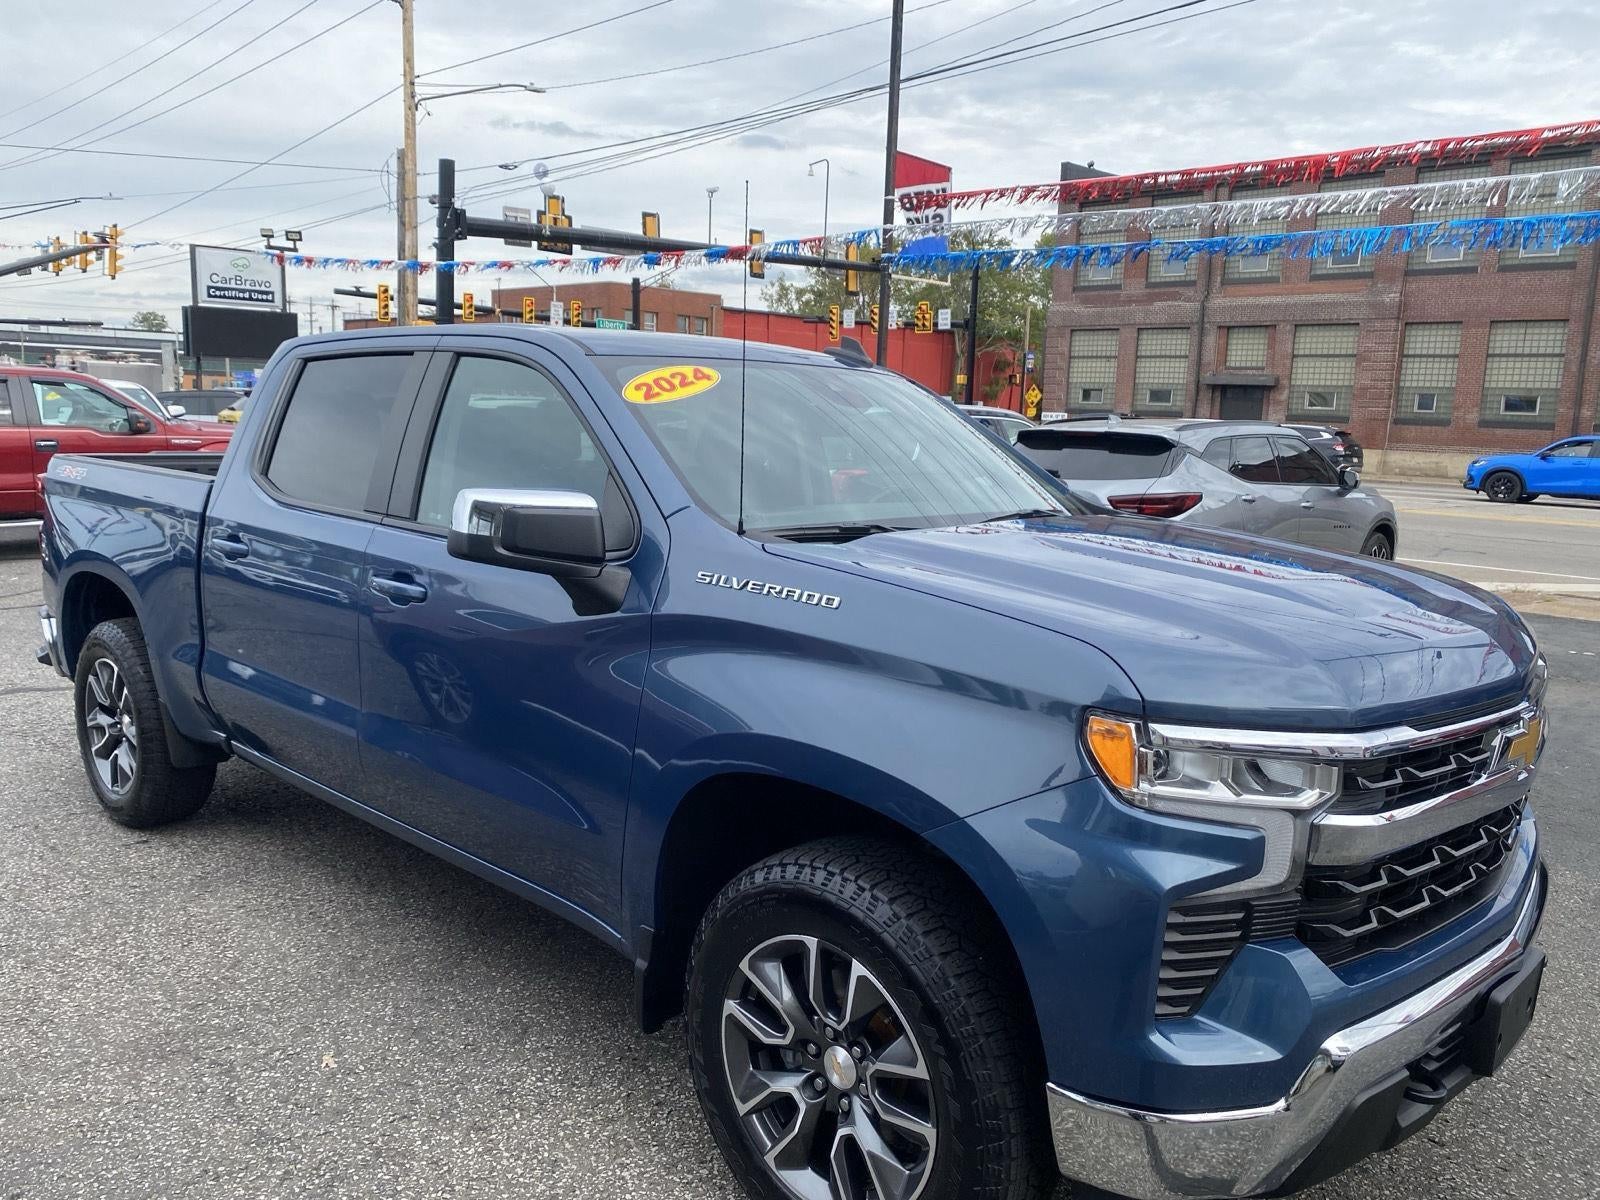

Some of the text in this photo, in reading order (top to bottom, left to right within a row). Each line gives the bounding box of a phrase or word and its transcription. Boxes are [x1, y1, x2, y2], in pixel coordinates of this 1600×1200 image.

[209, 272, 272, 289] CarBravo
[210, 288, 273, 300] Certified Used
[599, 320, 625, 330] Liberty
[633, 367, 712, 400] 2024
[695, 570, 842, 610] SILVERADO
